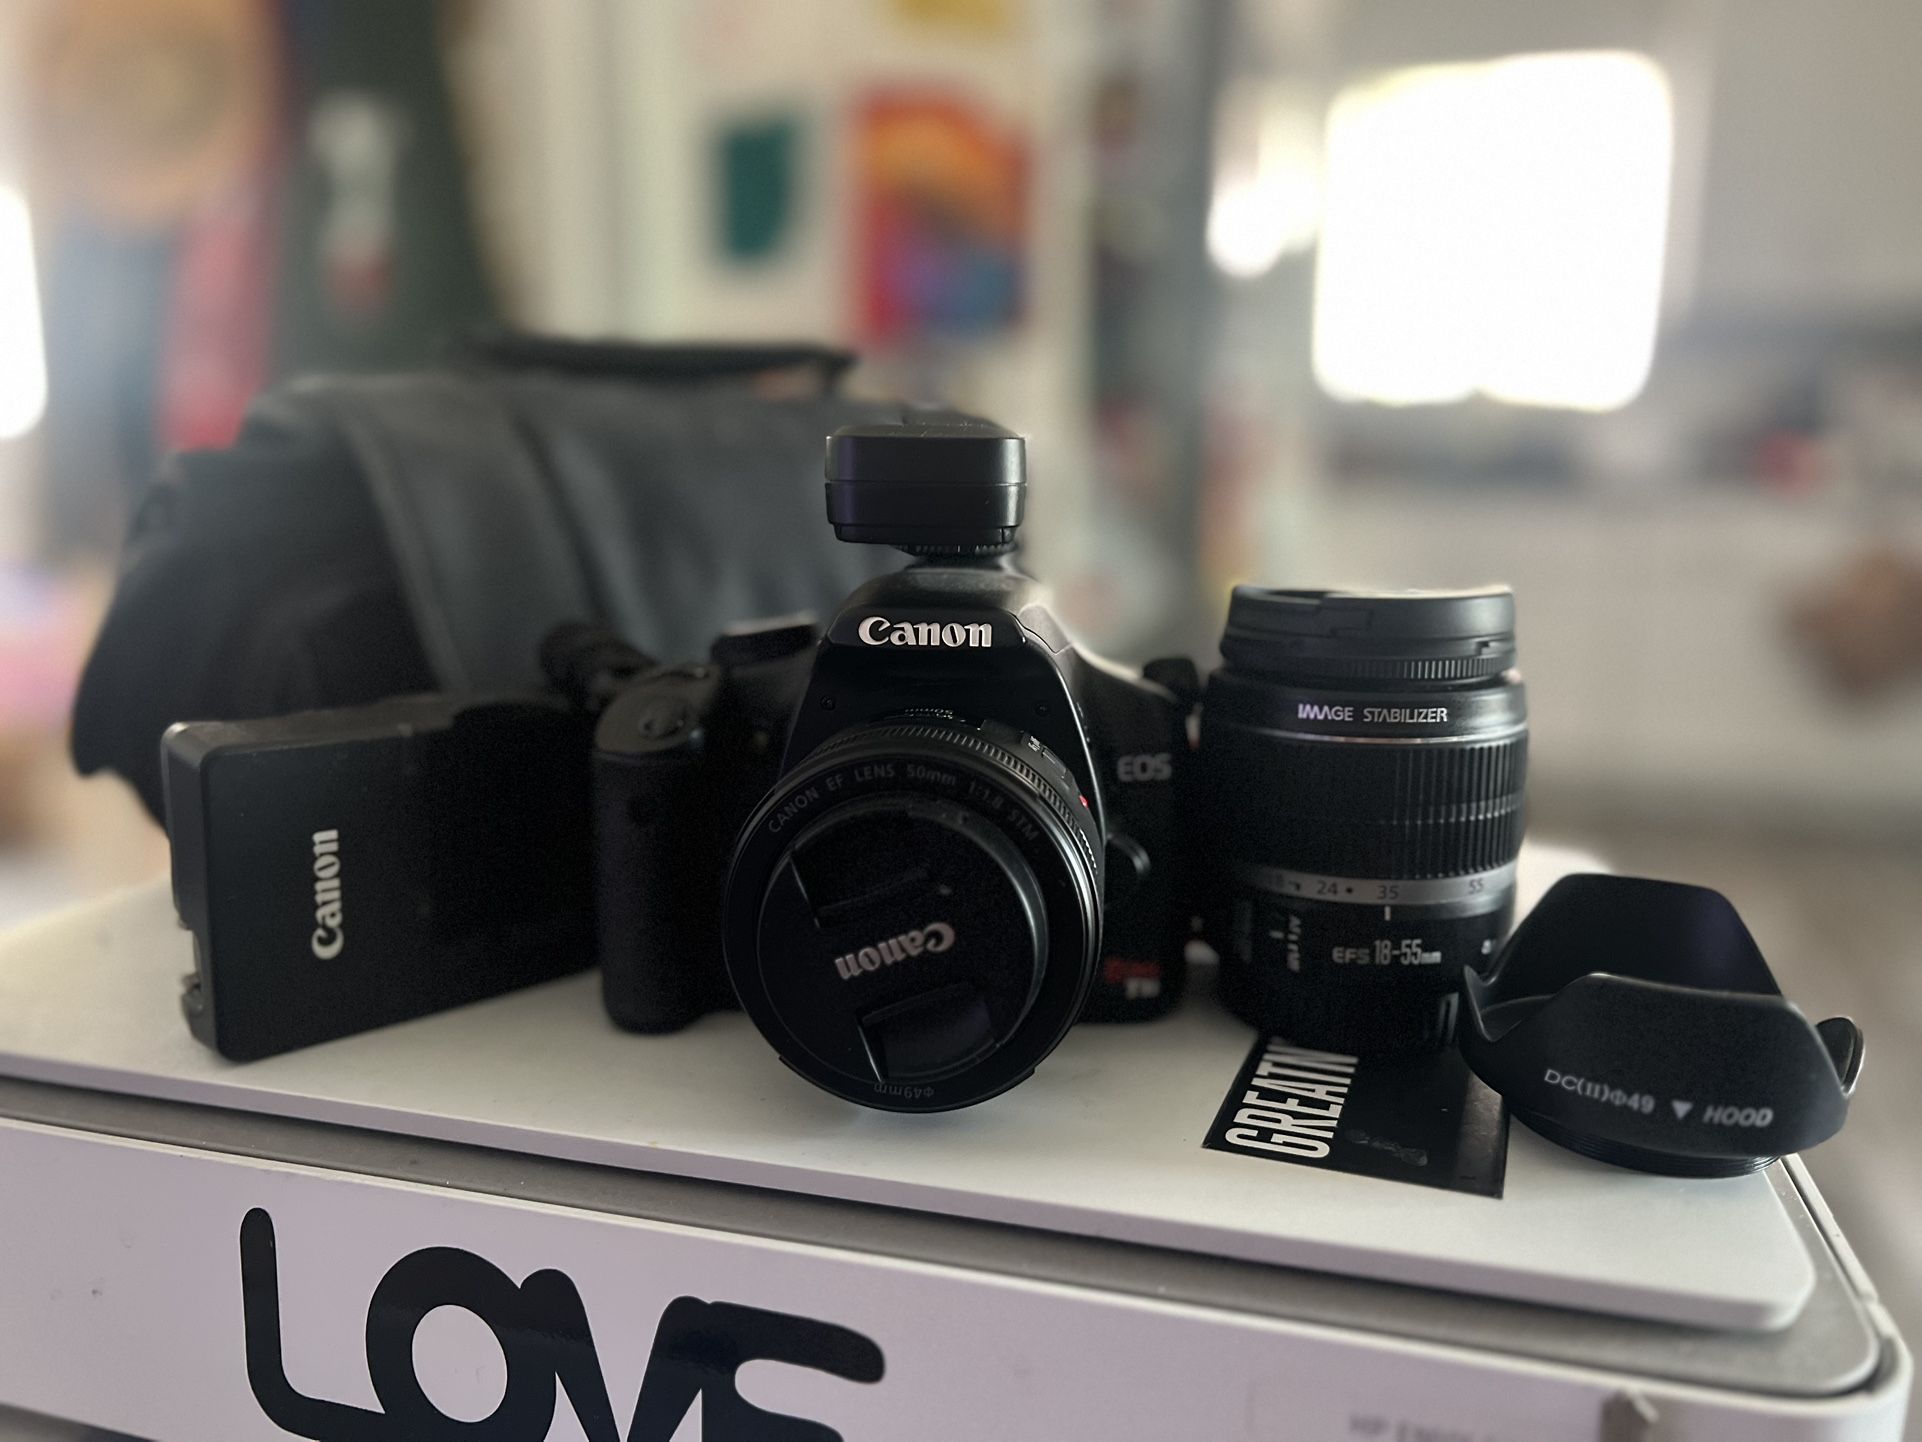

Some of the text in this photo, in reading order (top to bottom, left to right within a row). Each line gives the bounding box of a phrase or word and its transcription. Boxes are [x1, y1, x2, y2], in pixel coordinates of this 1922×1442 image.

[858, 616, 993, 647] Canon
[1297, 703, 1449, 724] IMAGE STABILIZER
[1117, 753, 1172, 782] EOS
[767, 786, 821, 835] CANON
[825, 776, 845, 793] EF
[854, 763, 896, 783] LENS
[906, 763, 957, 786] 50mm
[1006, 806, 1041, 842] STM
[311, 828, 345, 960] Canon
[1316, 880, 1338, 896] 24
[1376, 884, 1400, 900] 35
[1468, 878, 1485, 894] 55
[833, 920, 958, 982] Canon
[1702, 1105, 1775, 1128] HOOD
